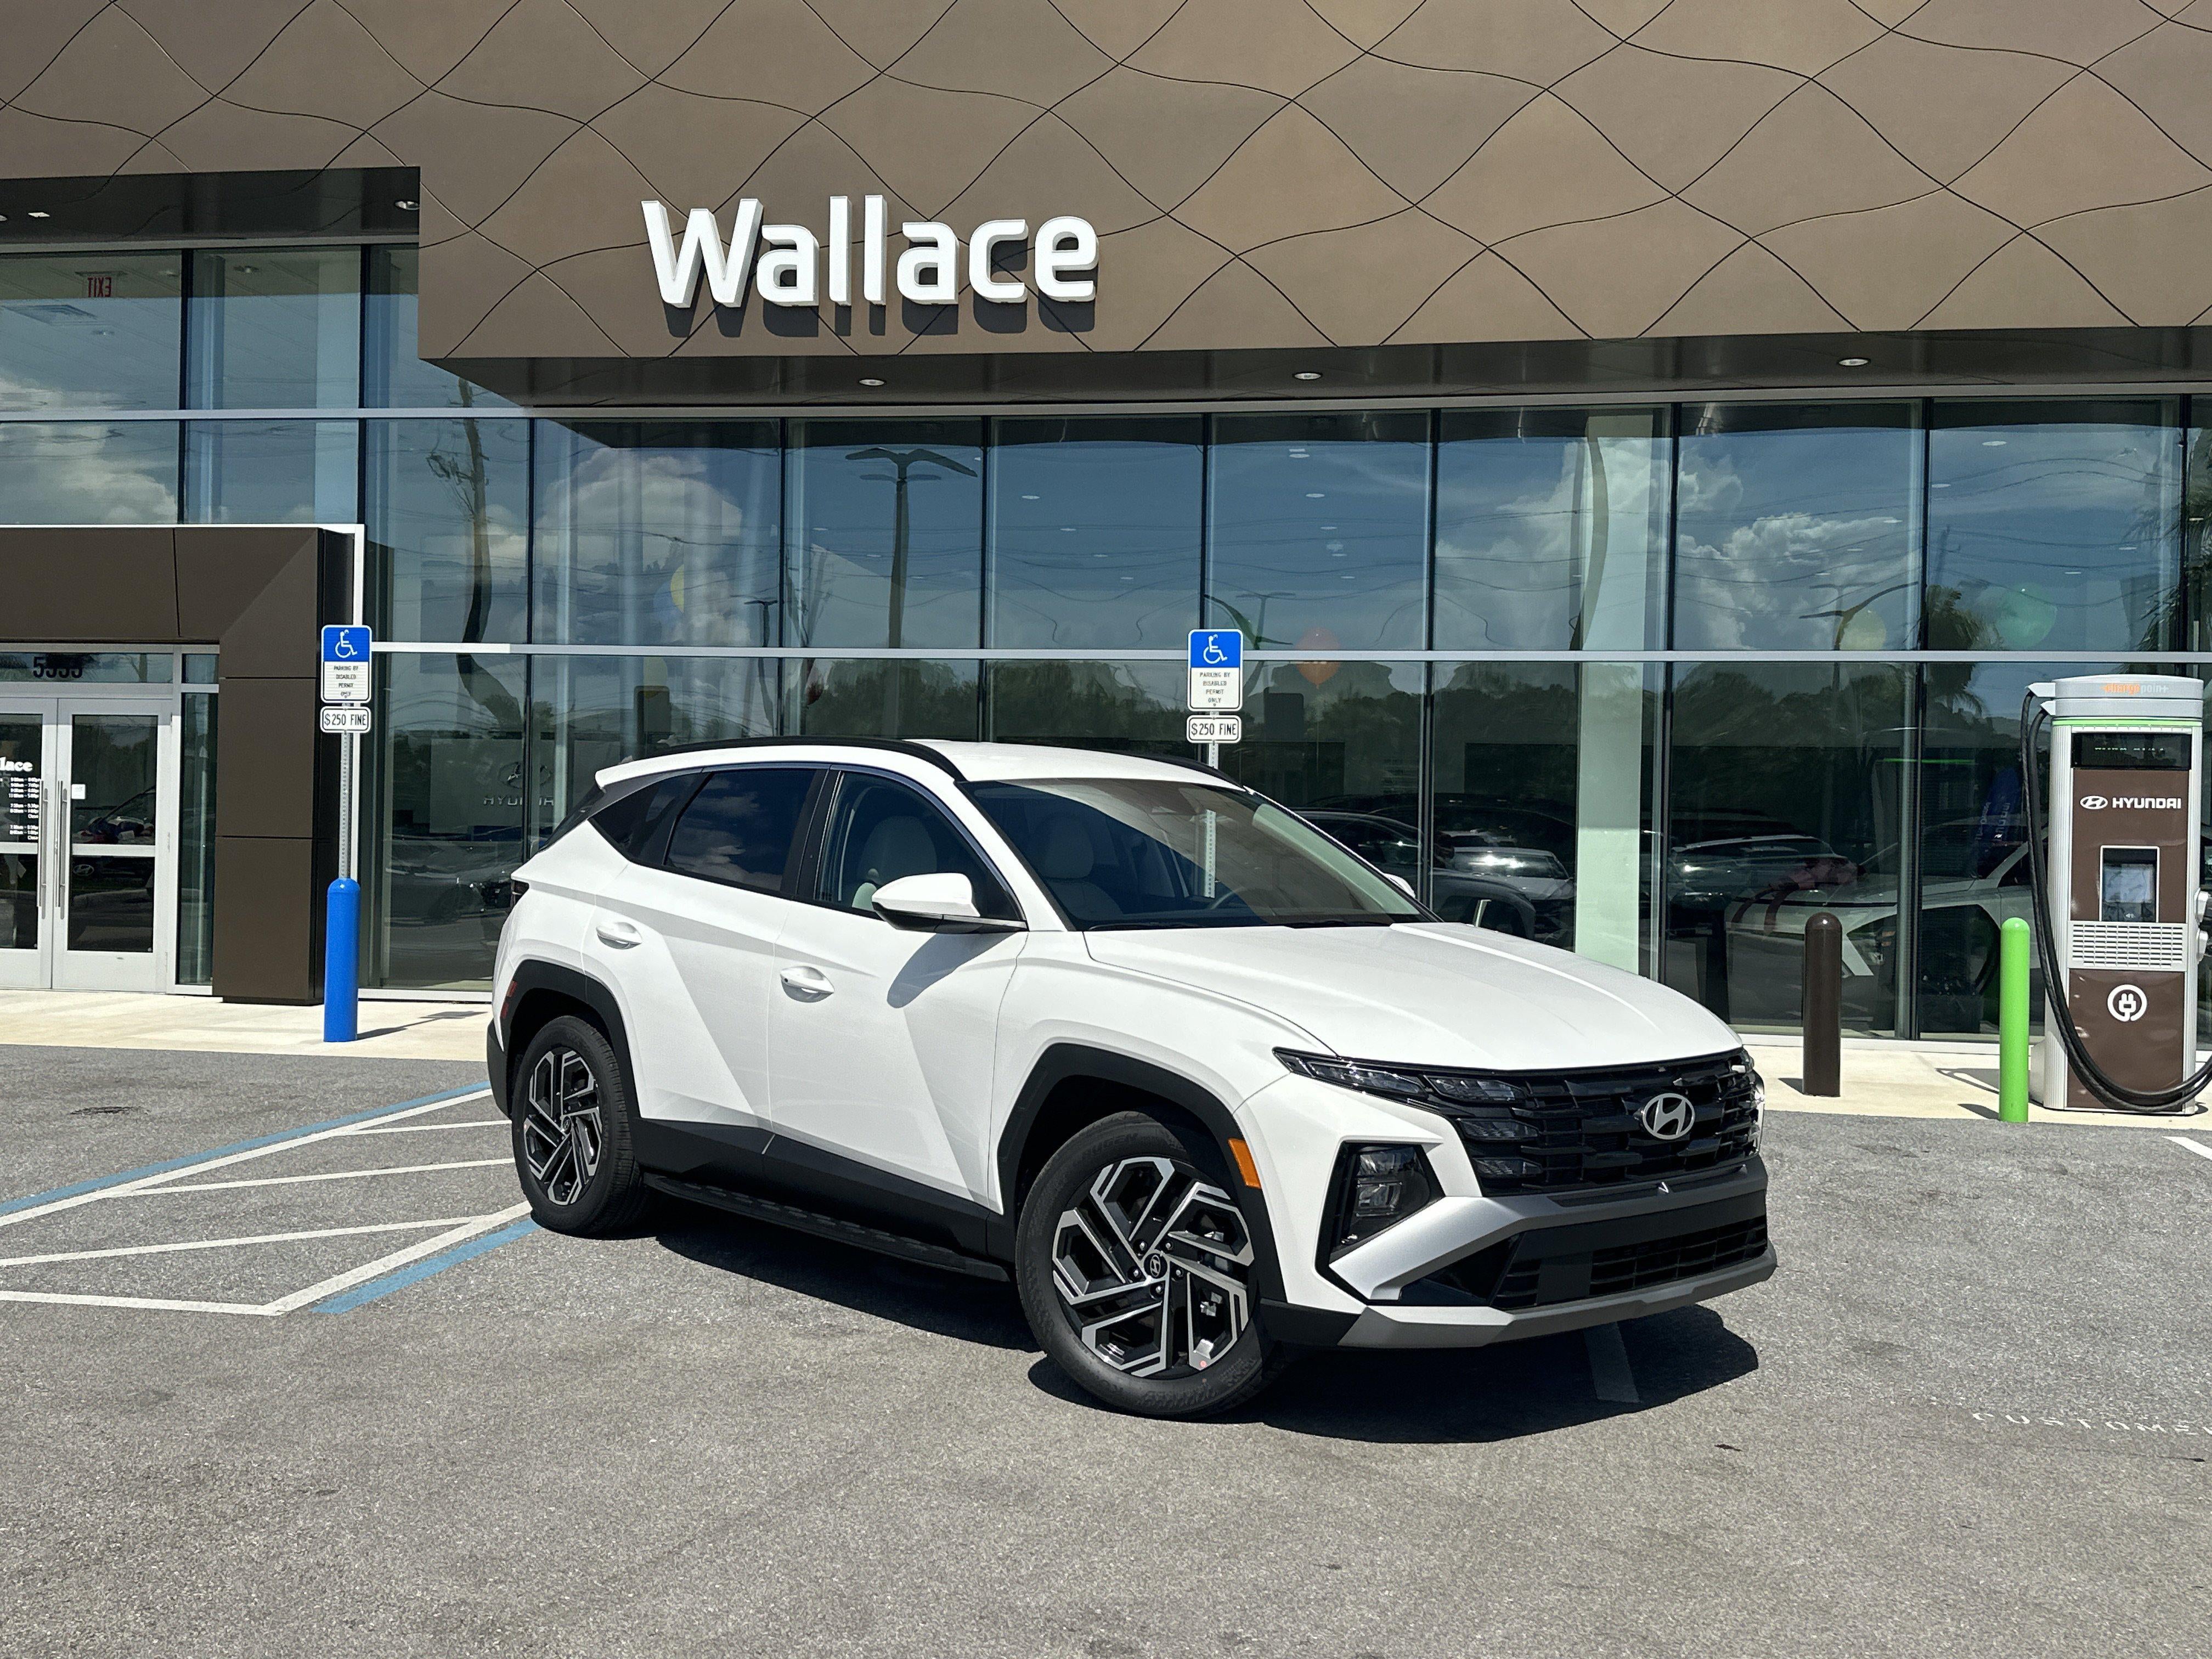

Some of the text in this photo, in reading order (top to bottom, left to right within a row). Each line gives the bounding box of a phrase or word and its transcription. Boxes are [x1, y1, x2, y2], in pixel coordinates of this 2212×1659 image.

[641, 194, 1099, 309] Wallace
[324, 714, 366, 726] $250 FINE
[1191, 723, 1237, 736] $250 FINE
[2112, 797, 2181, 809] HYUNDAI
